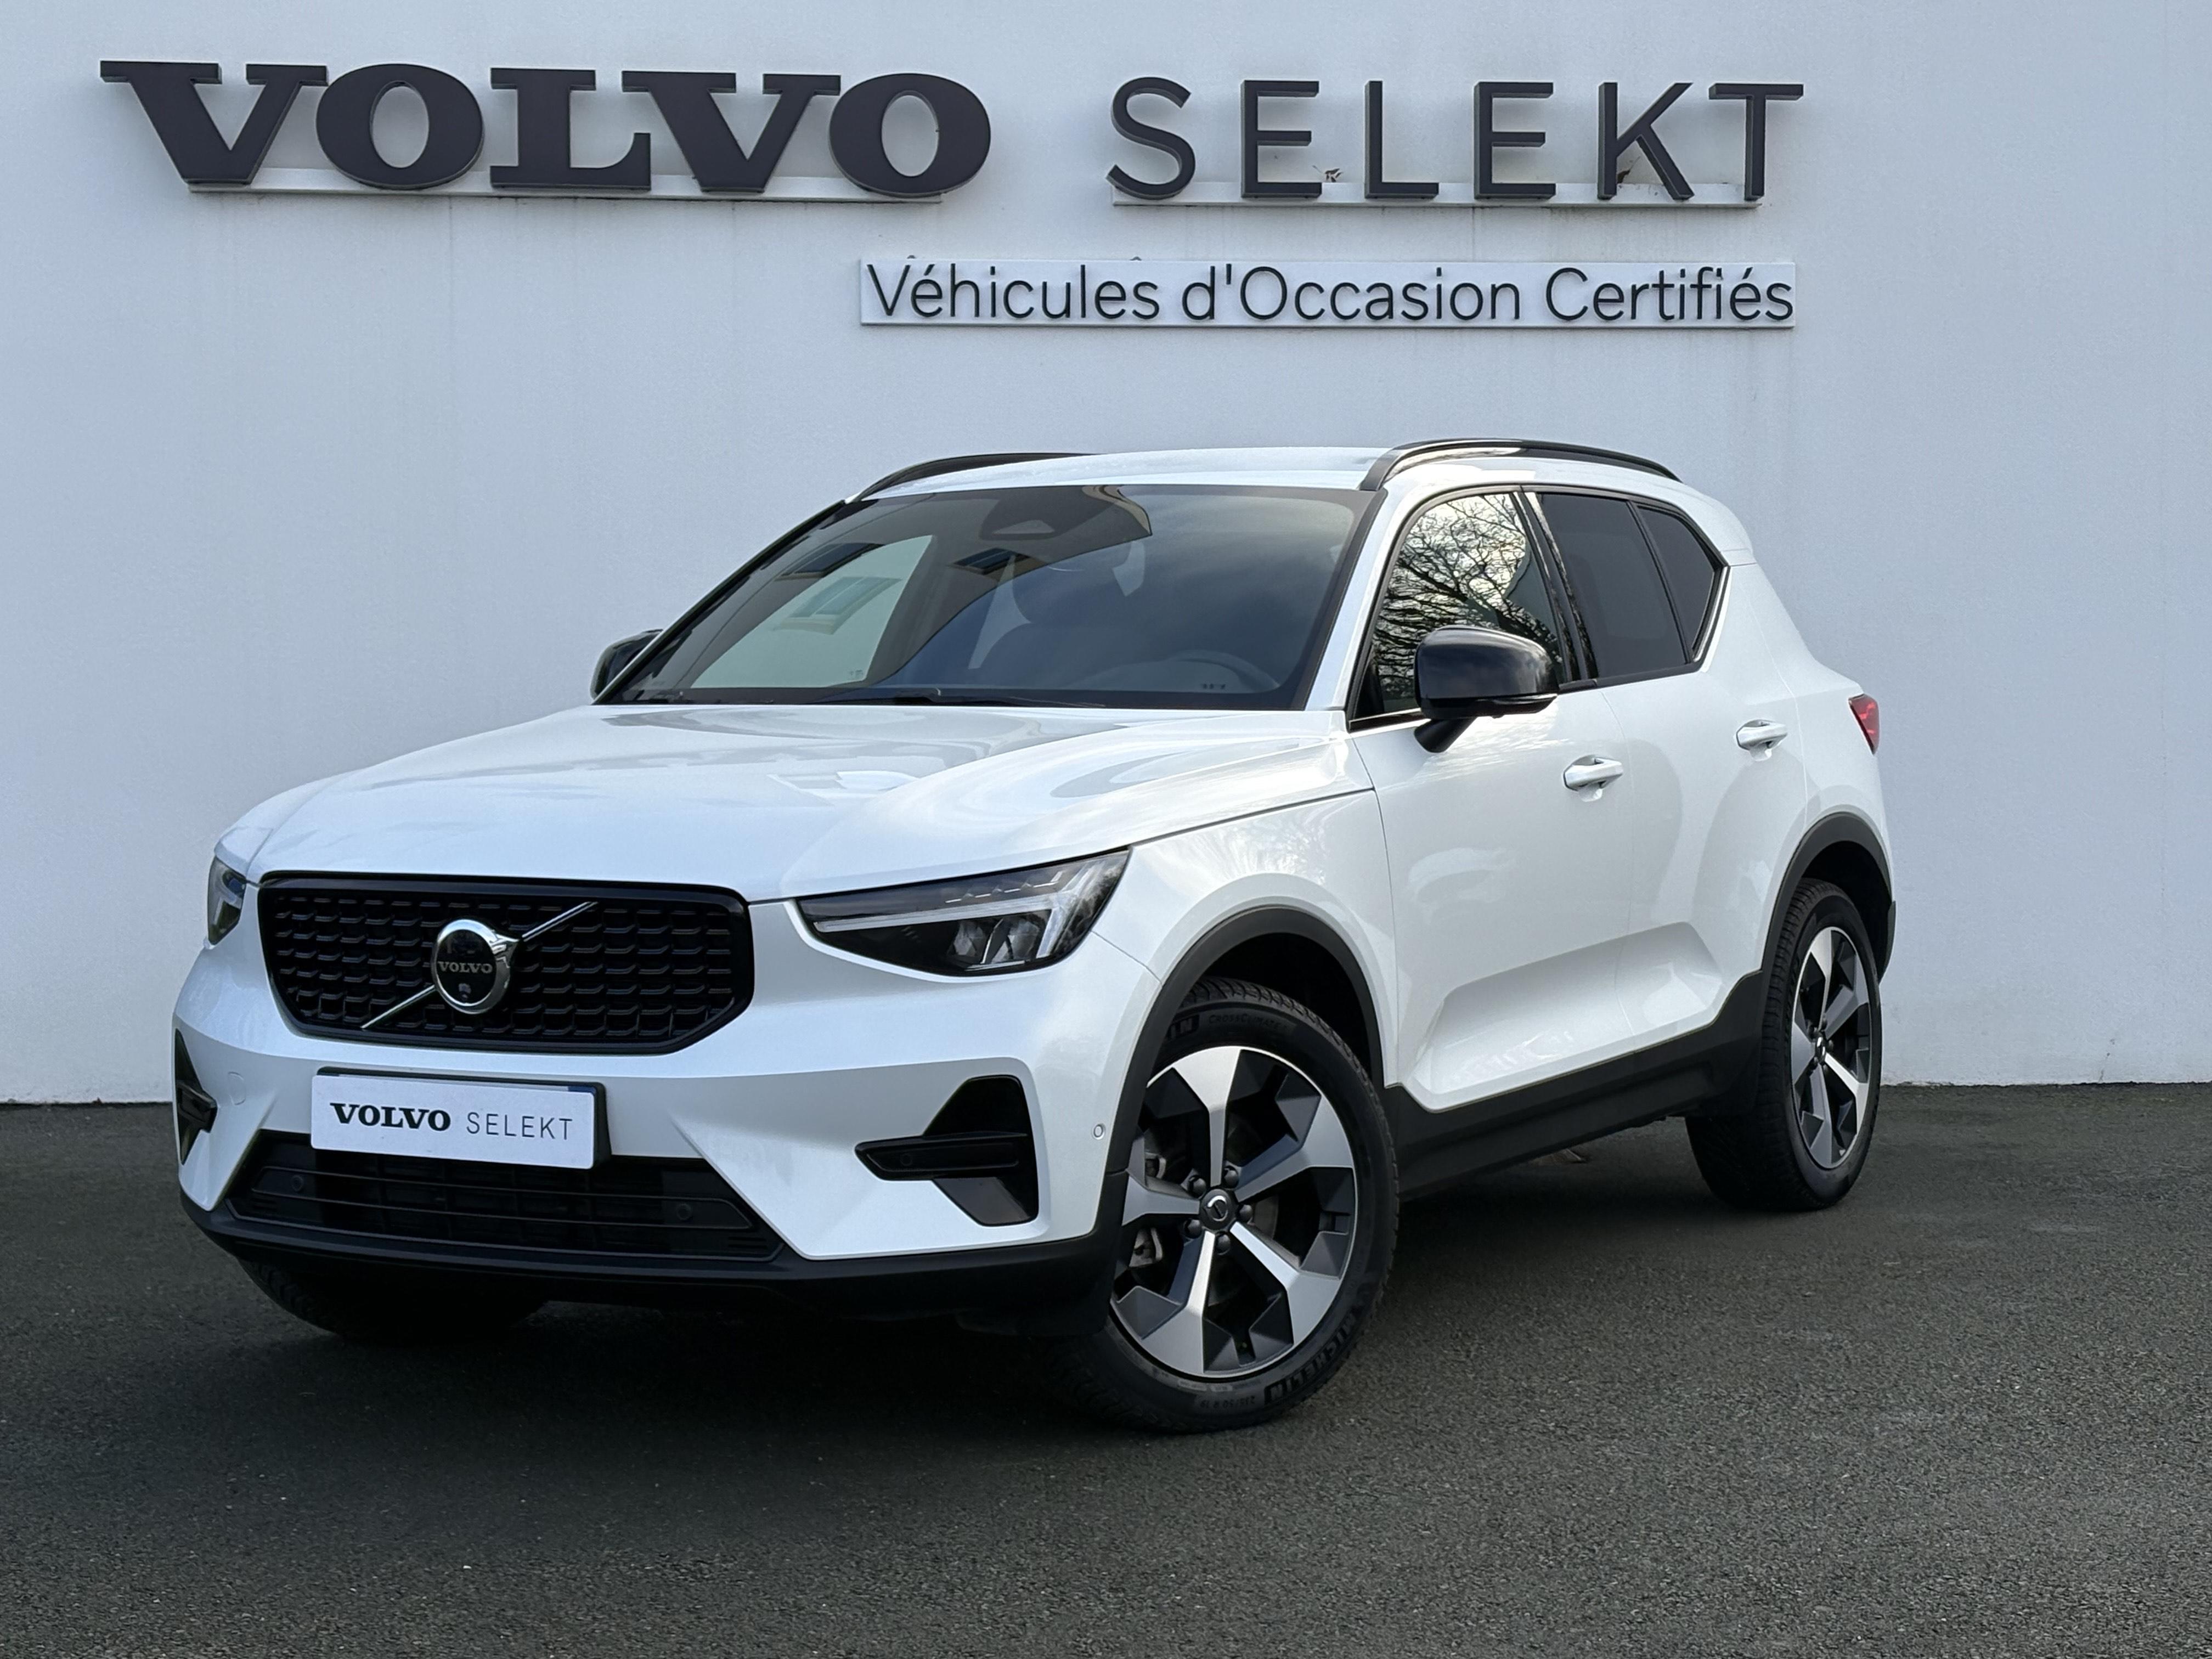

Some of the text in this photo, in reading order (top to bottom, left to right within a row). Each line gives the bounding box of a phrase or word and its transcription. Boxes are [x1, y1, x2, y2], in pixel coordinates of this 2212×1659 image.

[100, 60, 1804, 203] VOLVO SELEKT
[867, 263, 1793, 323] Véhicules d'Occasion Certifiés
[438, 961, 493, 974] VOLVO
[330, 1103, 573, 1141] VOLVO SELEKT
[1270, 1313, 1356, 1399] MICHELIN
